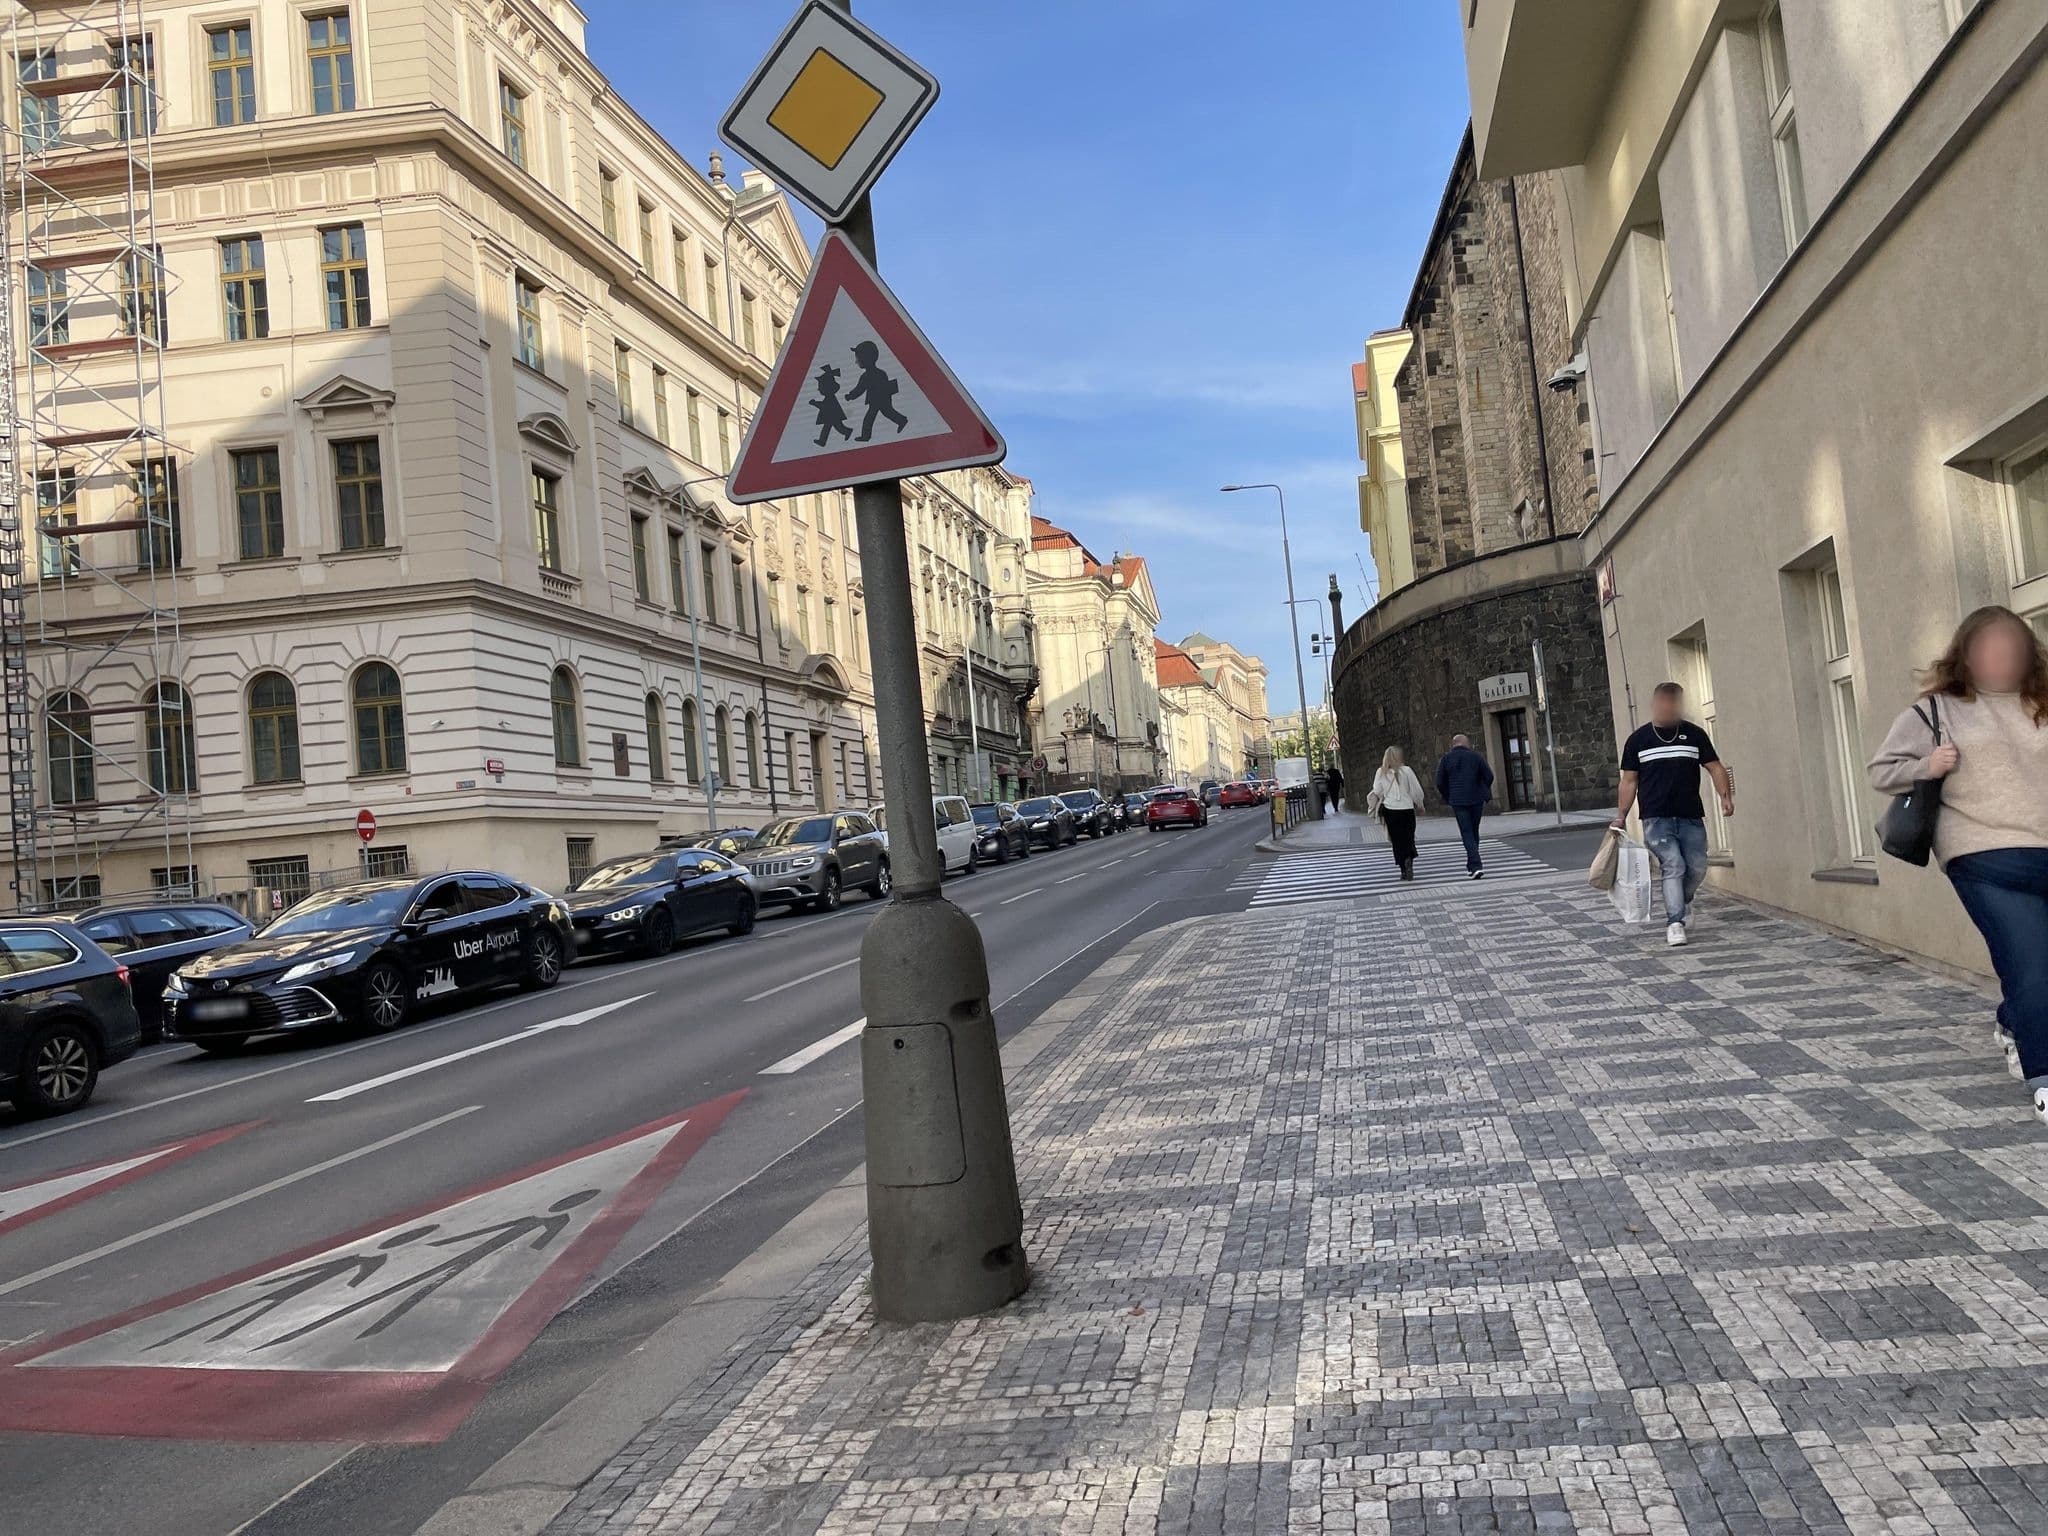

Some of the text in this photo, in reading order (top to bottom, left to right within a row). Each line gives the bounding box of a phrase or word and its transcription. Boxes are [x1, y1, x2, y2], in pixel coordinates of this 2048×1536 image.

[1484, 683, 1524, 698] GALERIE
[453, 940, 484, 959] Uber
[485, 927, 520, 951] Airport
